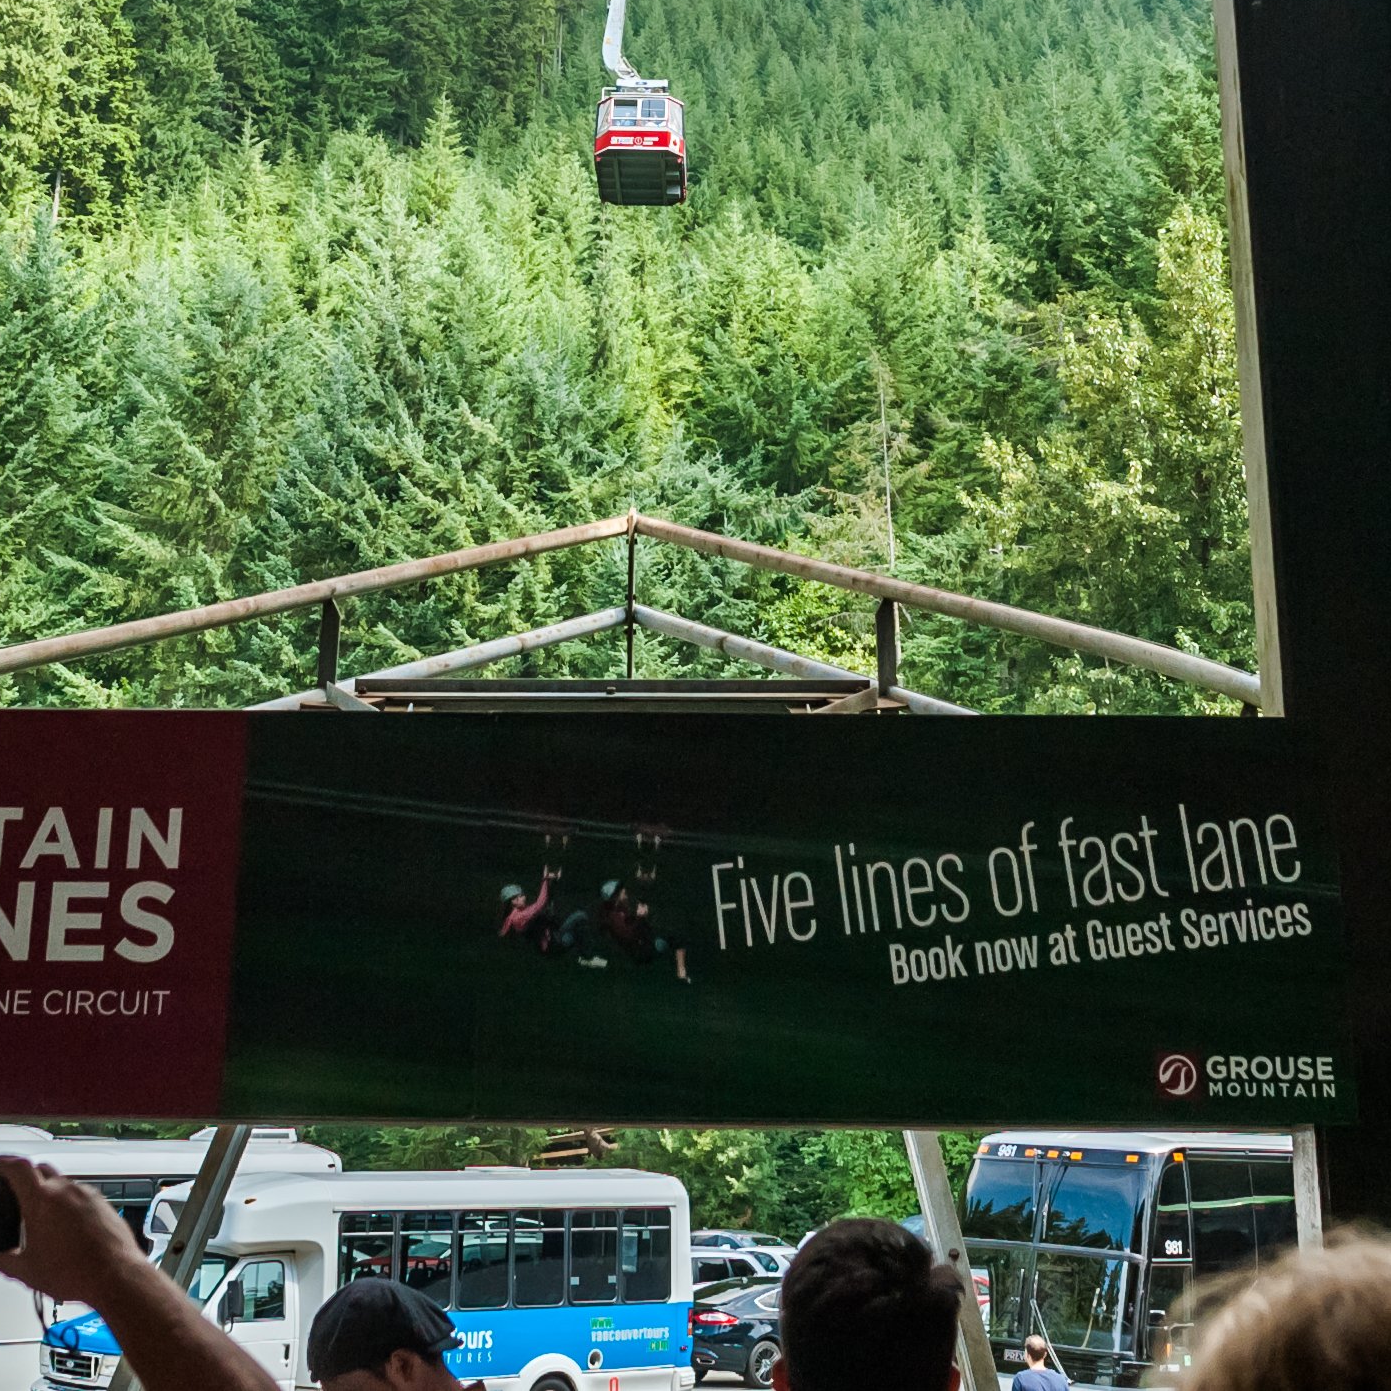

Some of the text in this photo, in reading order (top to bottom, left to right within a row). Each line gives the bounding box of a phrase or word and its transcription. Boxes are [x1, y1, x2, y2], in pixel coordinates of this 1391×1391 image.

[711, 803, 1301, 950] Five lines of fast lane
[888, 899, 1312, 985] Book now at Guest Services
[42, 989, 171, 1017] CIRCUIT
[1205, 1055, 1335, 1081] GROUSE
[1209, 1082, 1337, 1098] MOUNTAIN
[997, 1144, 1018, 1157] 981
[1164, 1239, 1183, 1255] 981
[591, 1327, 669, 1342] vancouvertours
